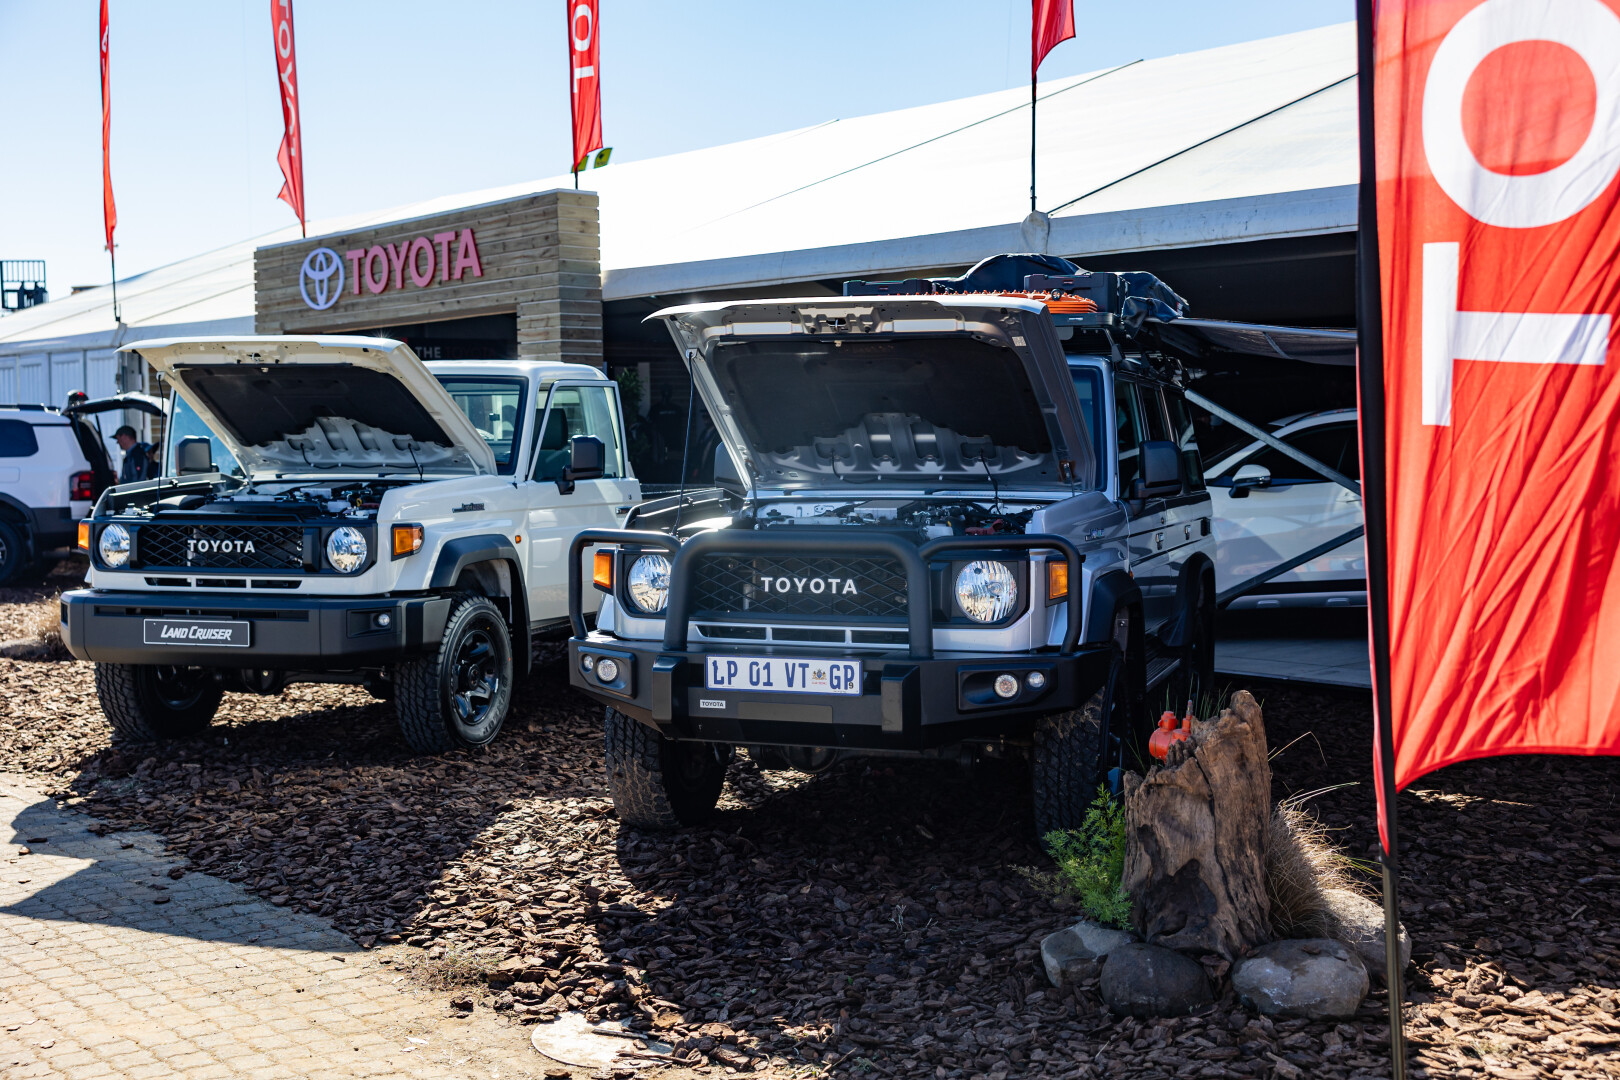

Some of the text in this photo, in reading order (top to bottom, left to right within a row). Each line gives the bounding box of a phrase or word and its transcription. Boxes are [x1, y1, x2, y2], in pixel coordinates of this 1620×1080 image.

[345, 228, 484, 295] TOYOTA
[414, 346, 442, 359] THE
[187, 539, 256, 554] TOYOTA
[760, 577, 858, 595] TOYOTA
[160, 624, 233, 641] LAND CRUISER
[712, 660, 855, 690] LP 01 VT GP
